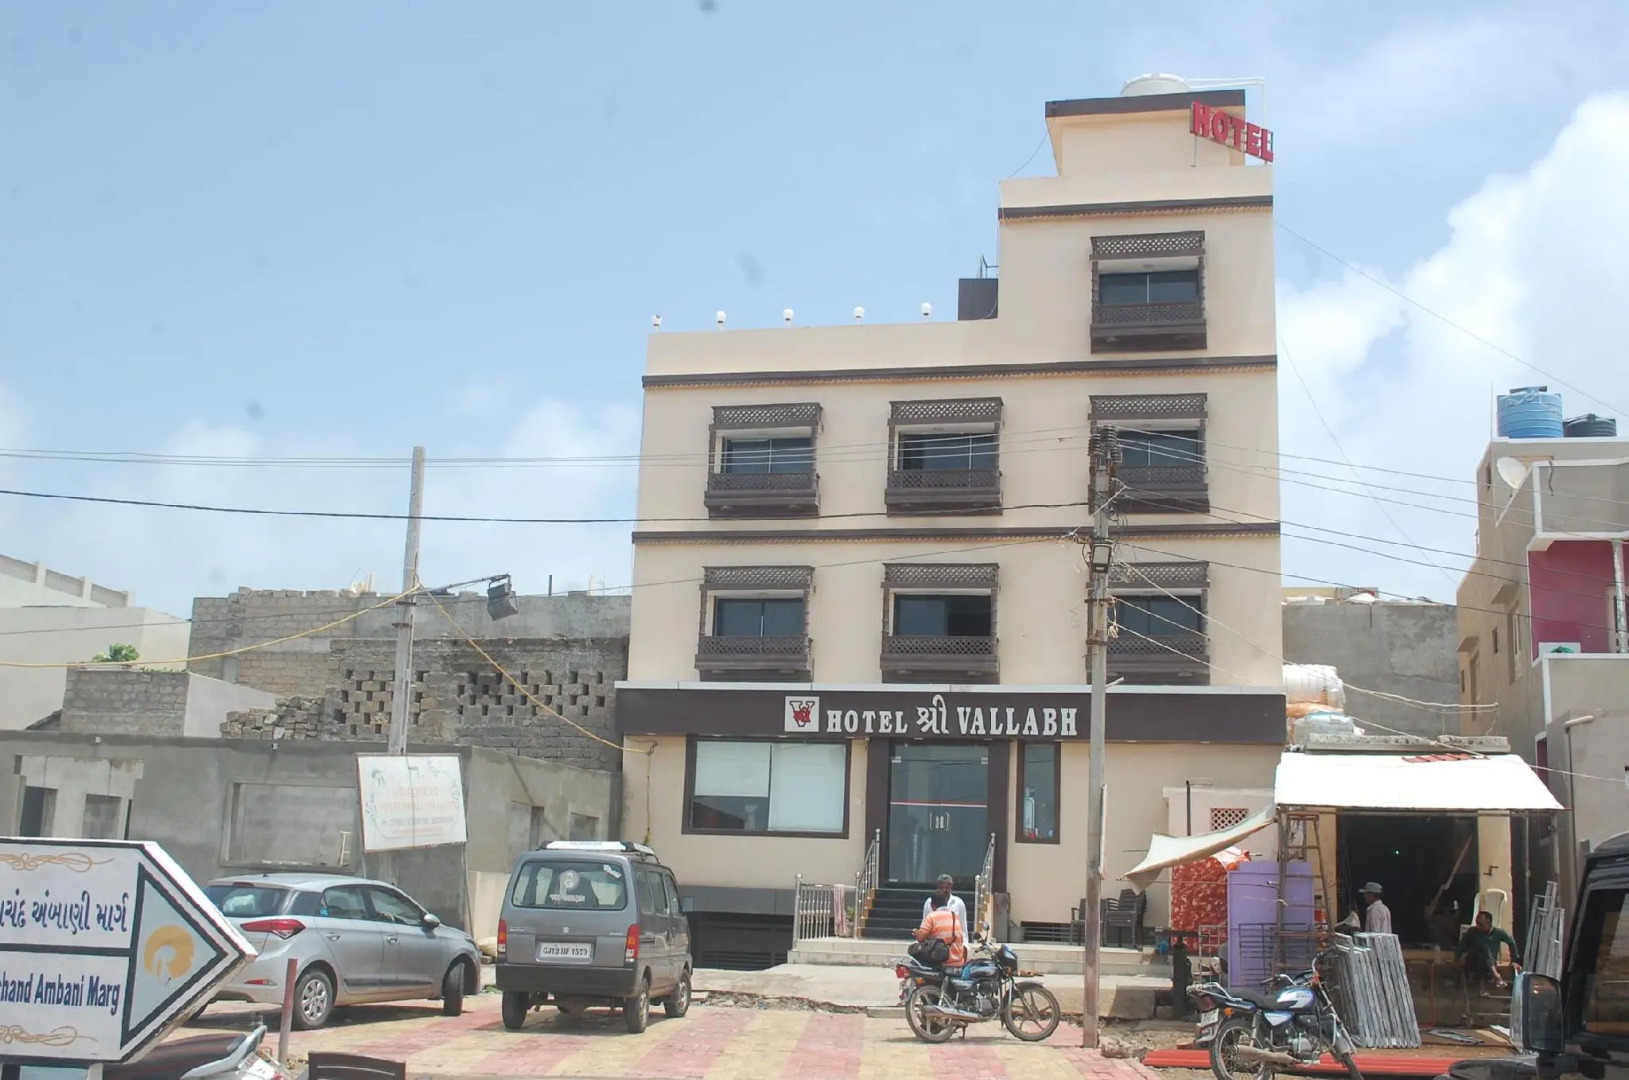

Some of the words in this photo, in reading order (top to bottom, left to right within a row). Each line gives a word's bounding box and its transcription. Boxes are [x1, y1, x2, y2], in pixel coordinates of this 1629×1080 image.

[1192, 101, 1273, 163] HOTEL
[827, 710, 908, 734] HOTEL
[957, 707, 1077, 736] VALLABH
[96, 892, 129, 932] માર્ગ
[0, 971, 33, 1004] hand
[34, 973, 84, 1007] Ambani
[86, 975, 121, 1016] Marg
